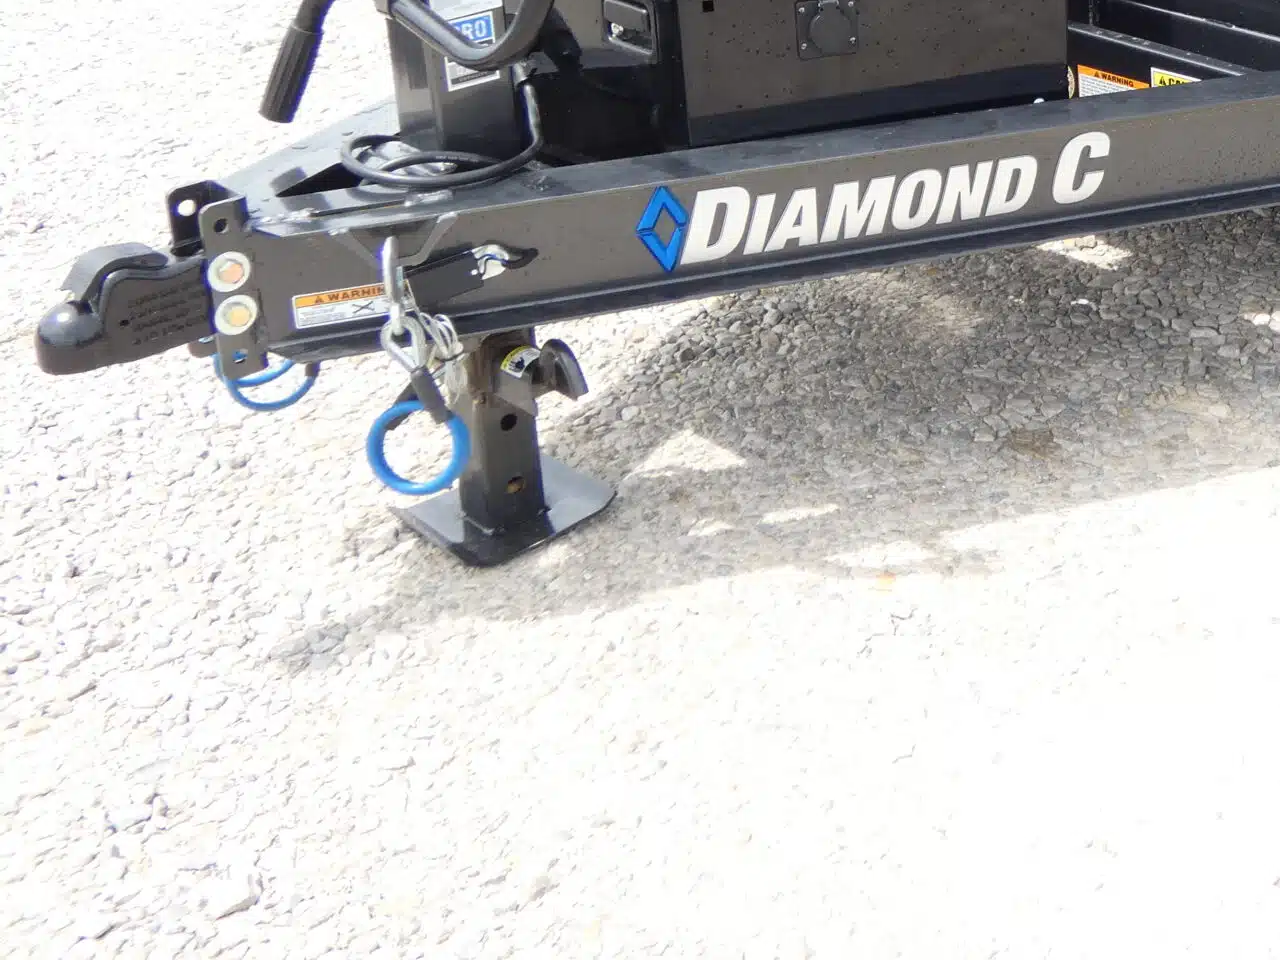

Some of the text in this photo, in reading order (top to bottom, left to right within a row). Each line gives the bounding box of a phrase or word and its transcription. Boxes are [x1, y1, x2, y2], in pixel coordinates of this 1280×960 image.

[456, 19, 487, 41] RO
[1101, 71, 1134, 88] WARNING
[680, 131, 1110, 265] DIAMOND C
[327, 286, 386, 302] WARNIN
